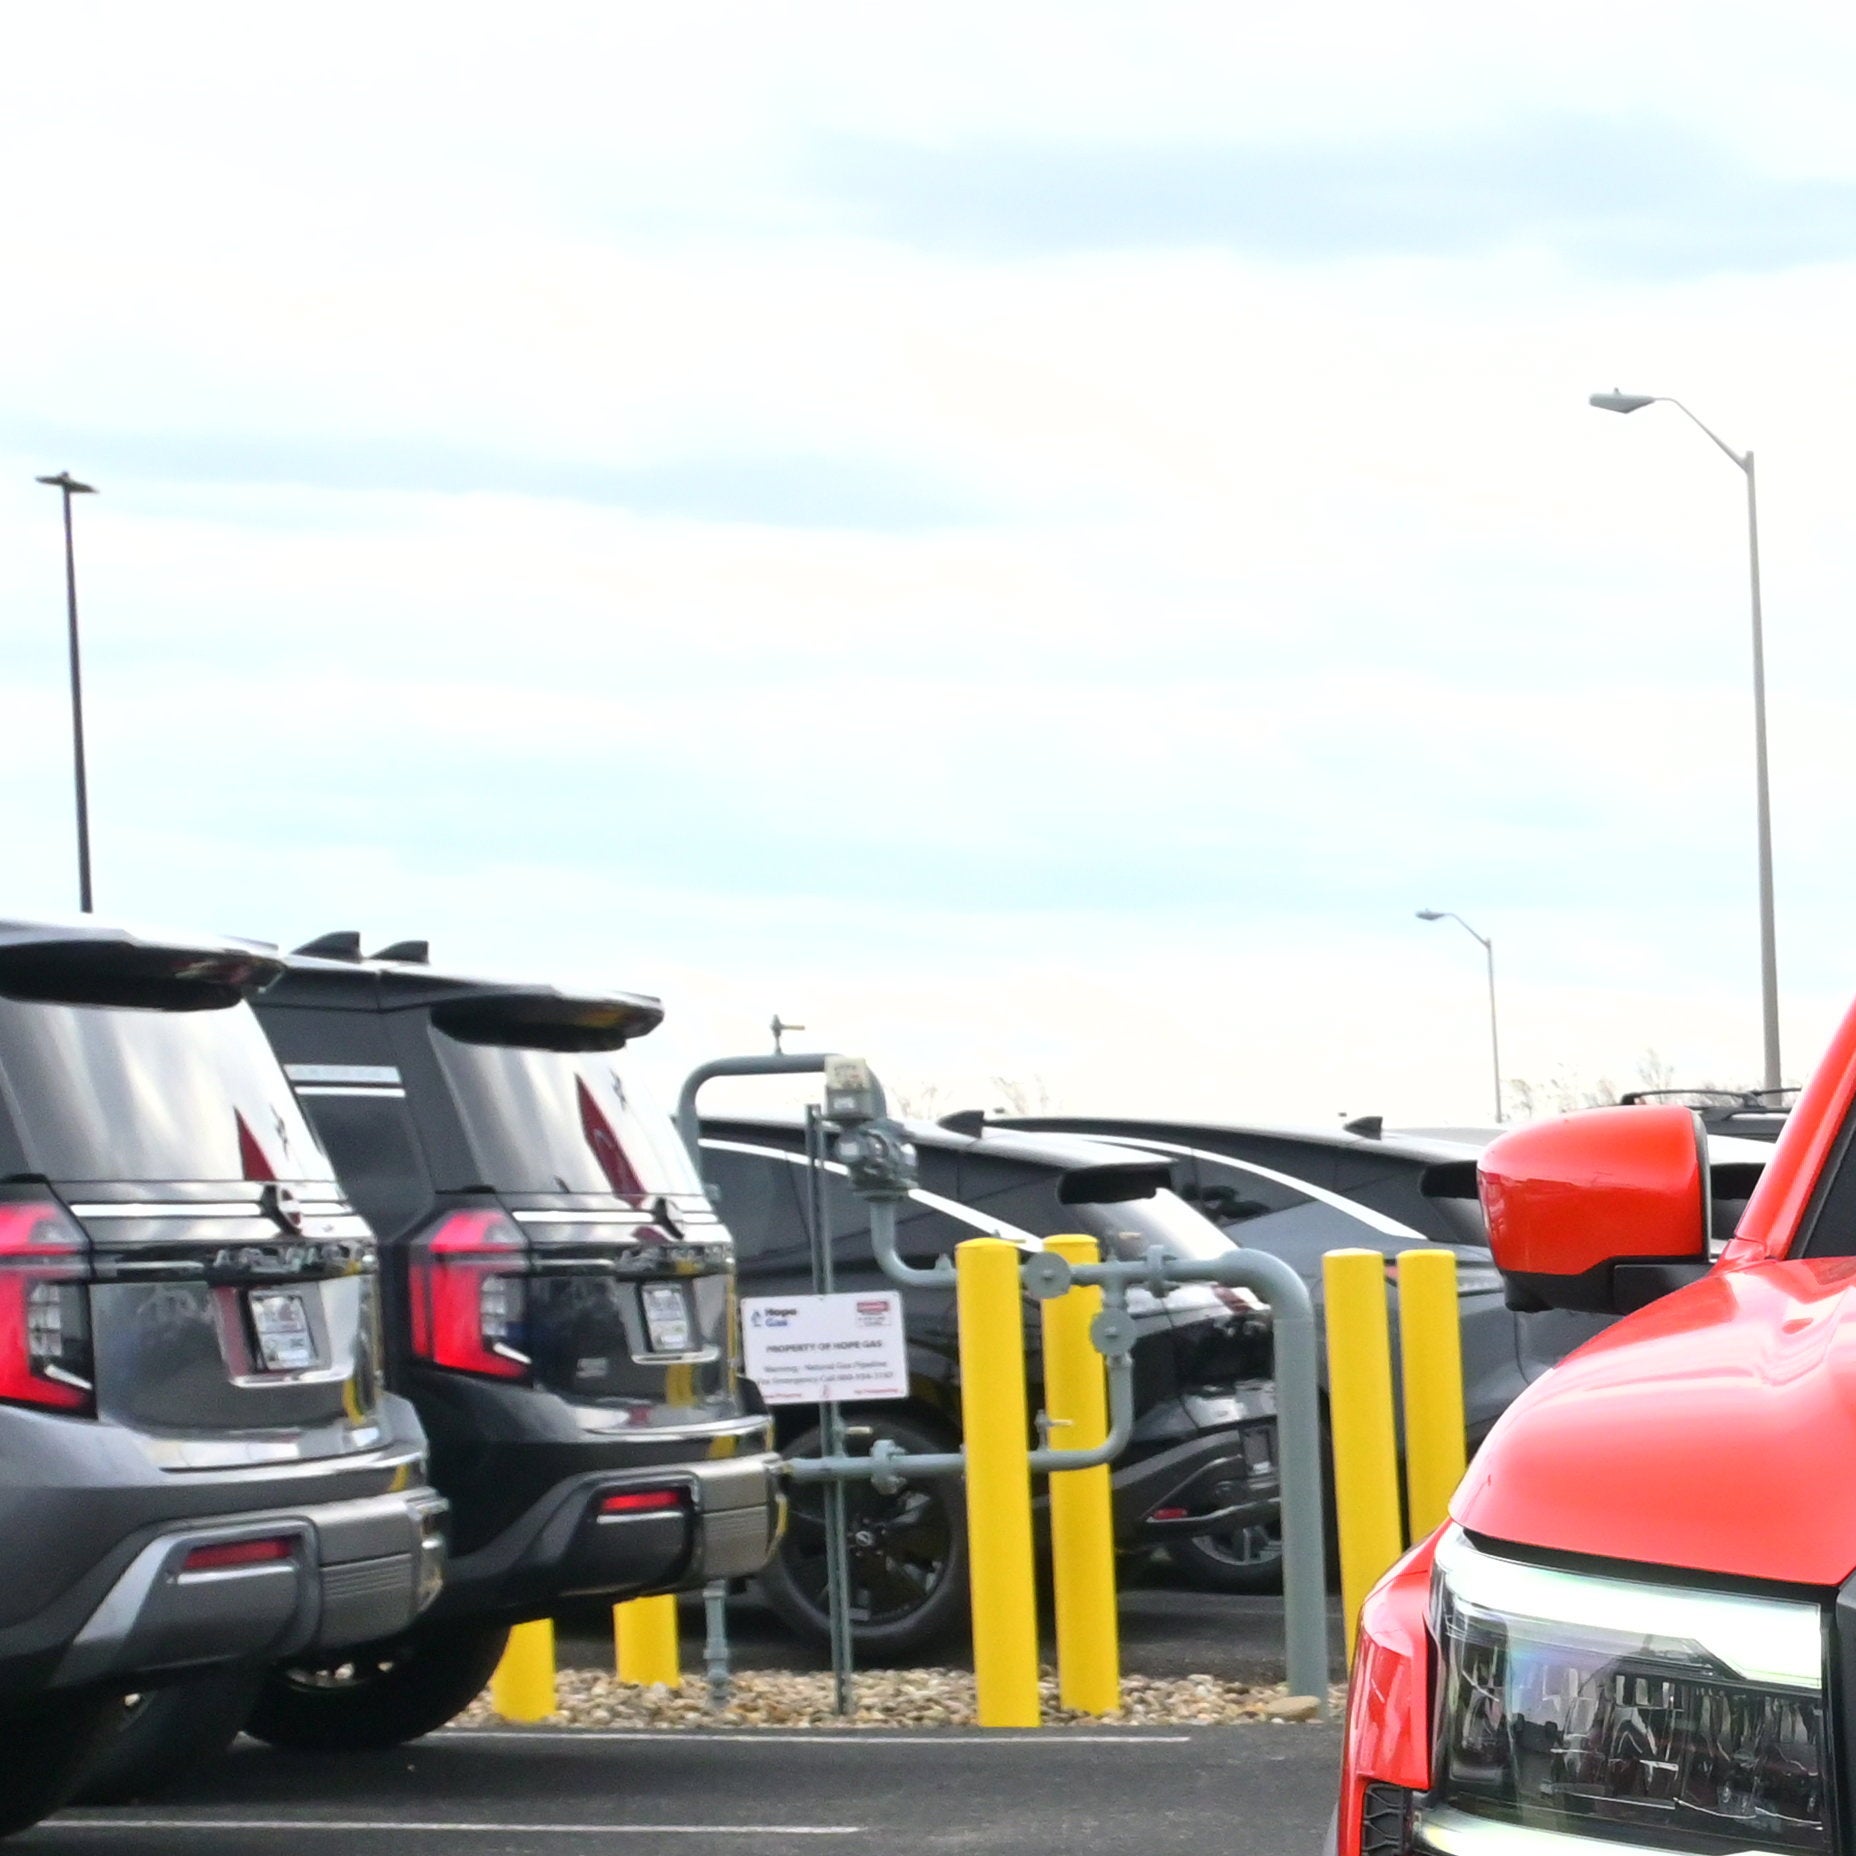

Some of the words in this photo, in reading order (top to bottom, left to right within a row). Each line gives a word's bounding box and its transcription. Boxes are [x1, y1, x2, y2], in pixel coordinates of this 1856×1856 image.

[764, 1307, 797, 1318] Hope
[765, 1317, 788, 1327] Gas
[766, 1342, 815, 1353] PROPERTY
[819, 1342, 831, 1351] OF
[833, 1341, 861, 1350] HOPE
[863, 1340, 882, 1349] GAS
